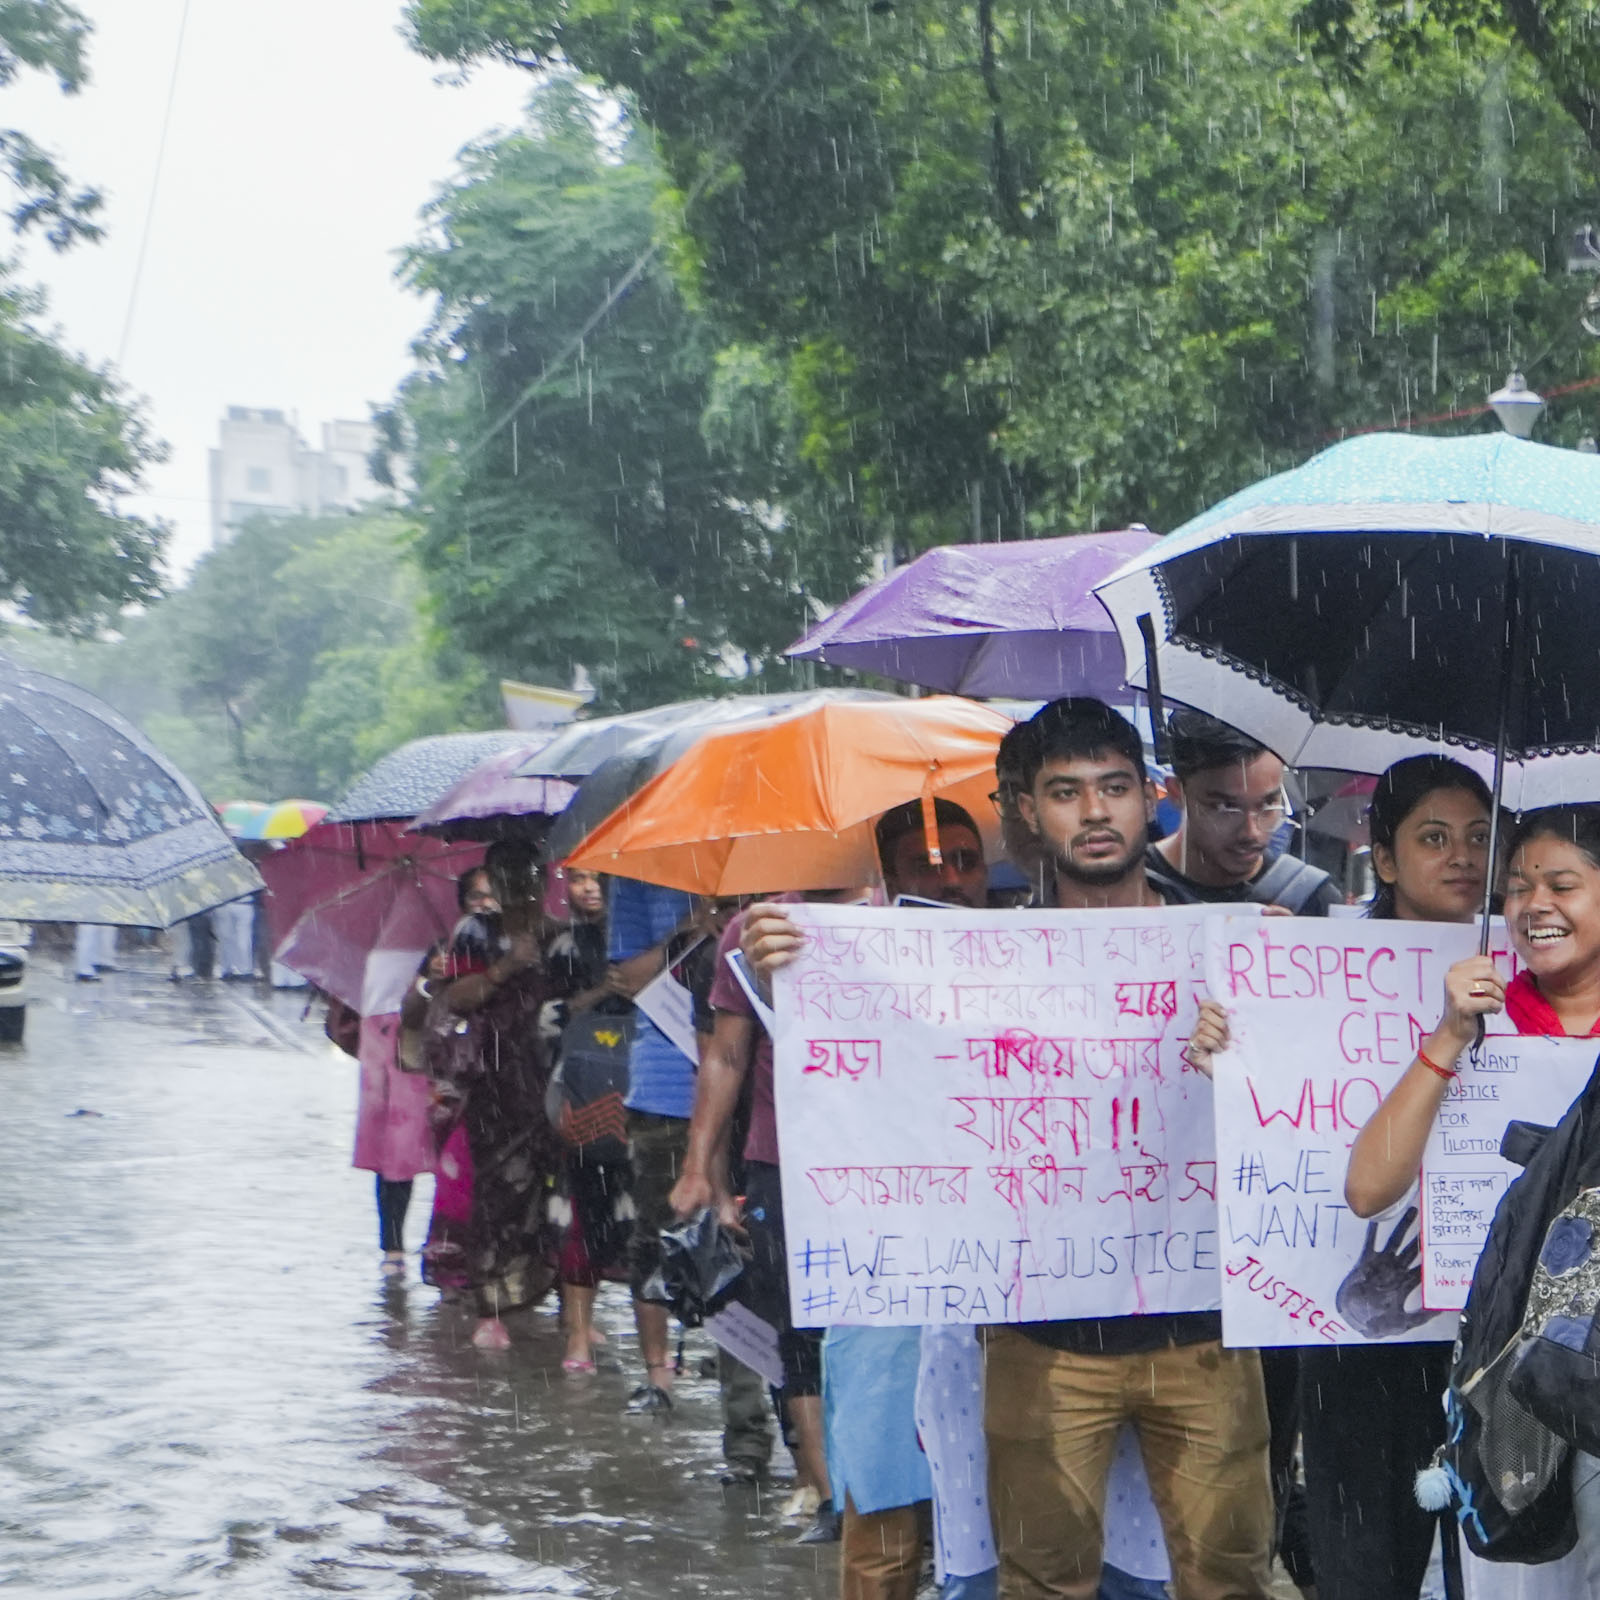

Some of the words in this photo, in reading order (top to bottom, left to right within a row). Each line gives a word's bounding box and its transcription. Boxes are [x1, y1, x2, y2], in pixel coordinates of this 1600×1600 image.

[1229, 943, 1433, 1003] RESPECT
[1233, 1150, 1331, 1195] #WE
[1227, 1203, 1348, 1248] WANT
[802, 1284, 1015, 1319] #ASHTRAY
